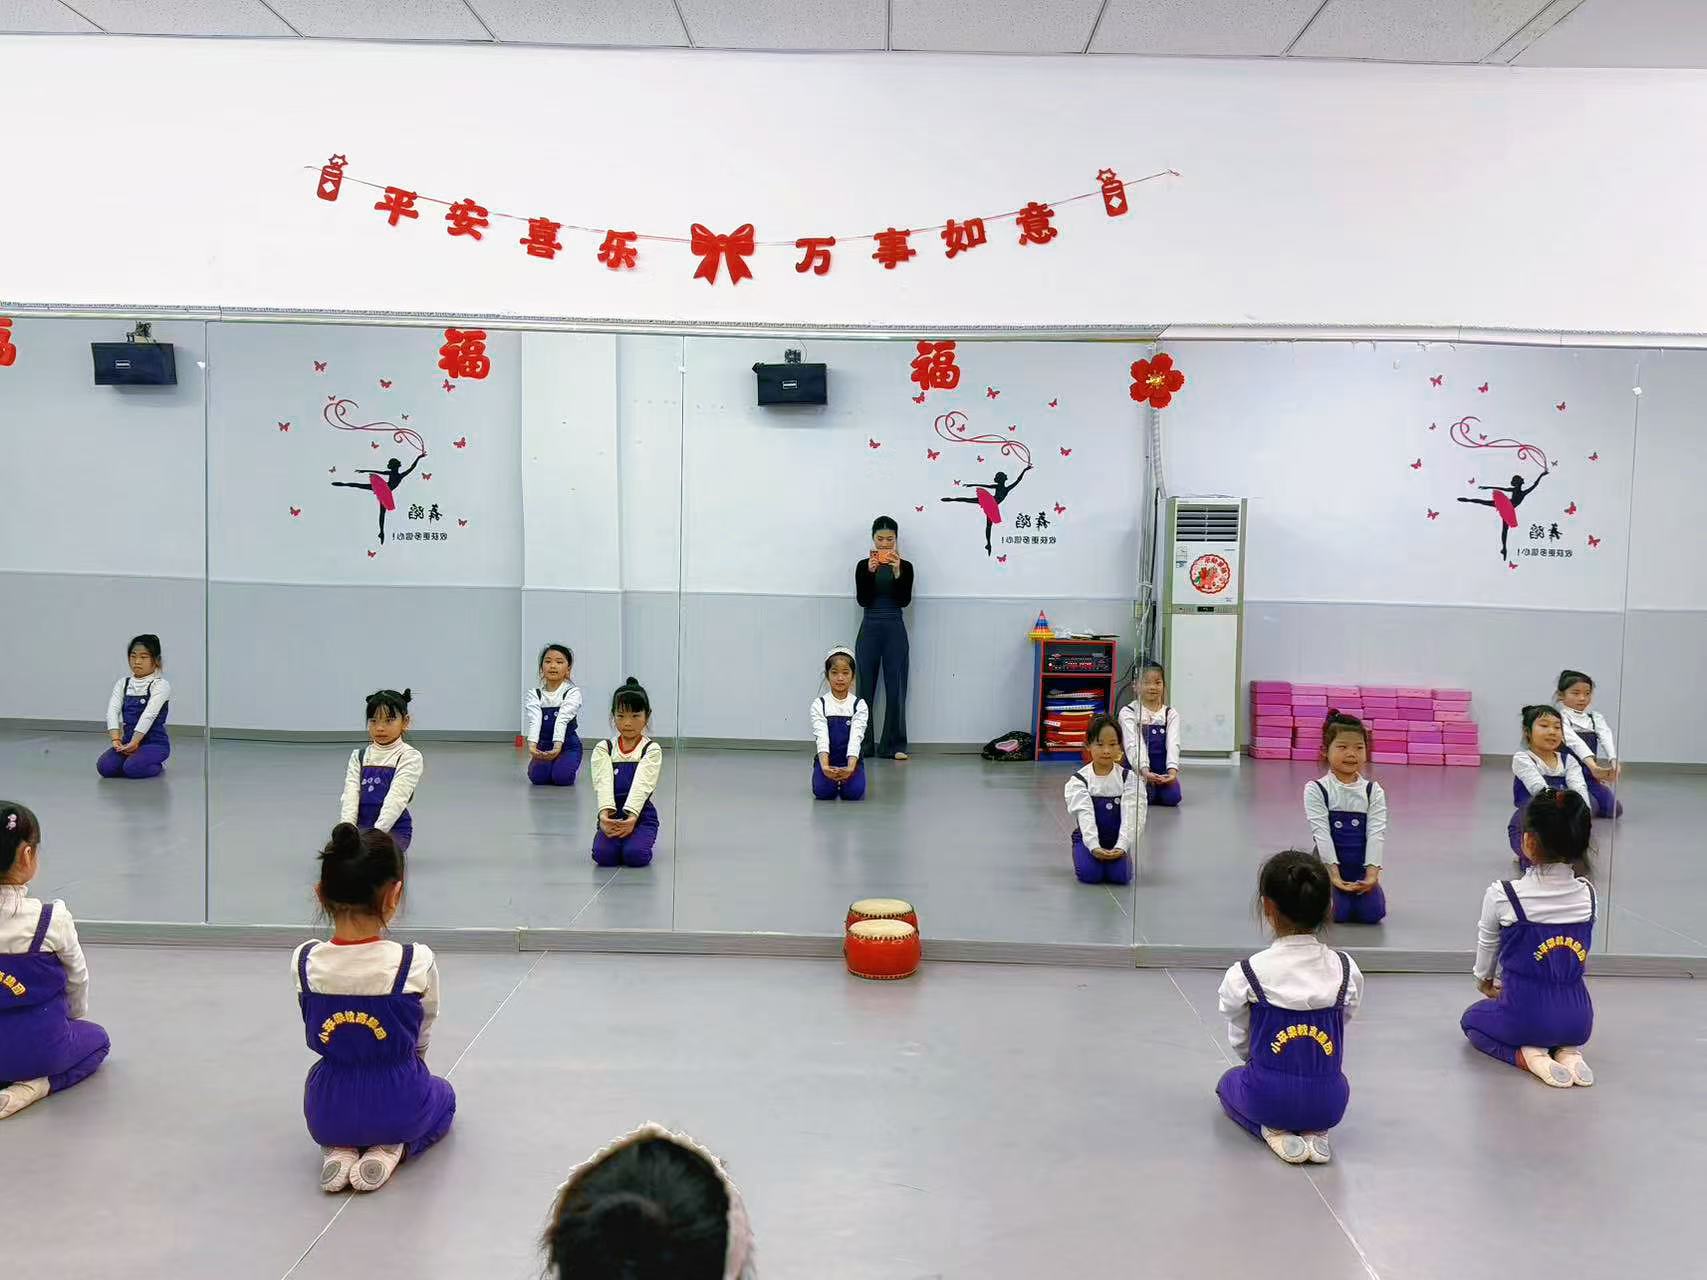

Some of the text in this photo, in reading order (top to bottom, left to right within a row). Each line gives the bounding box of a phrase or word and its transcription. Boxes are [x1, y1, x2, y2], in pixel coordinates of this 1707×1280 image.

[375, 187, 1058, 276] 平安喜乐 万事如意
[439, 328, 491, 381] 福
[911, 340, 961, 392] 福
